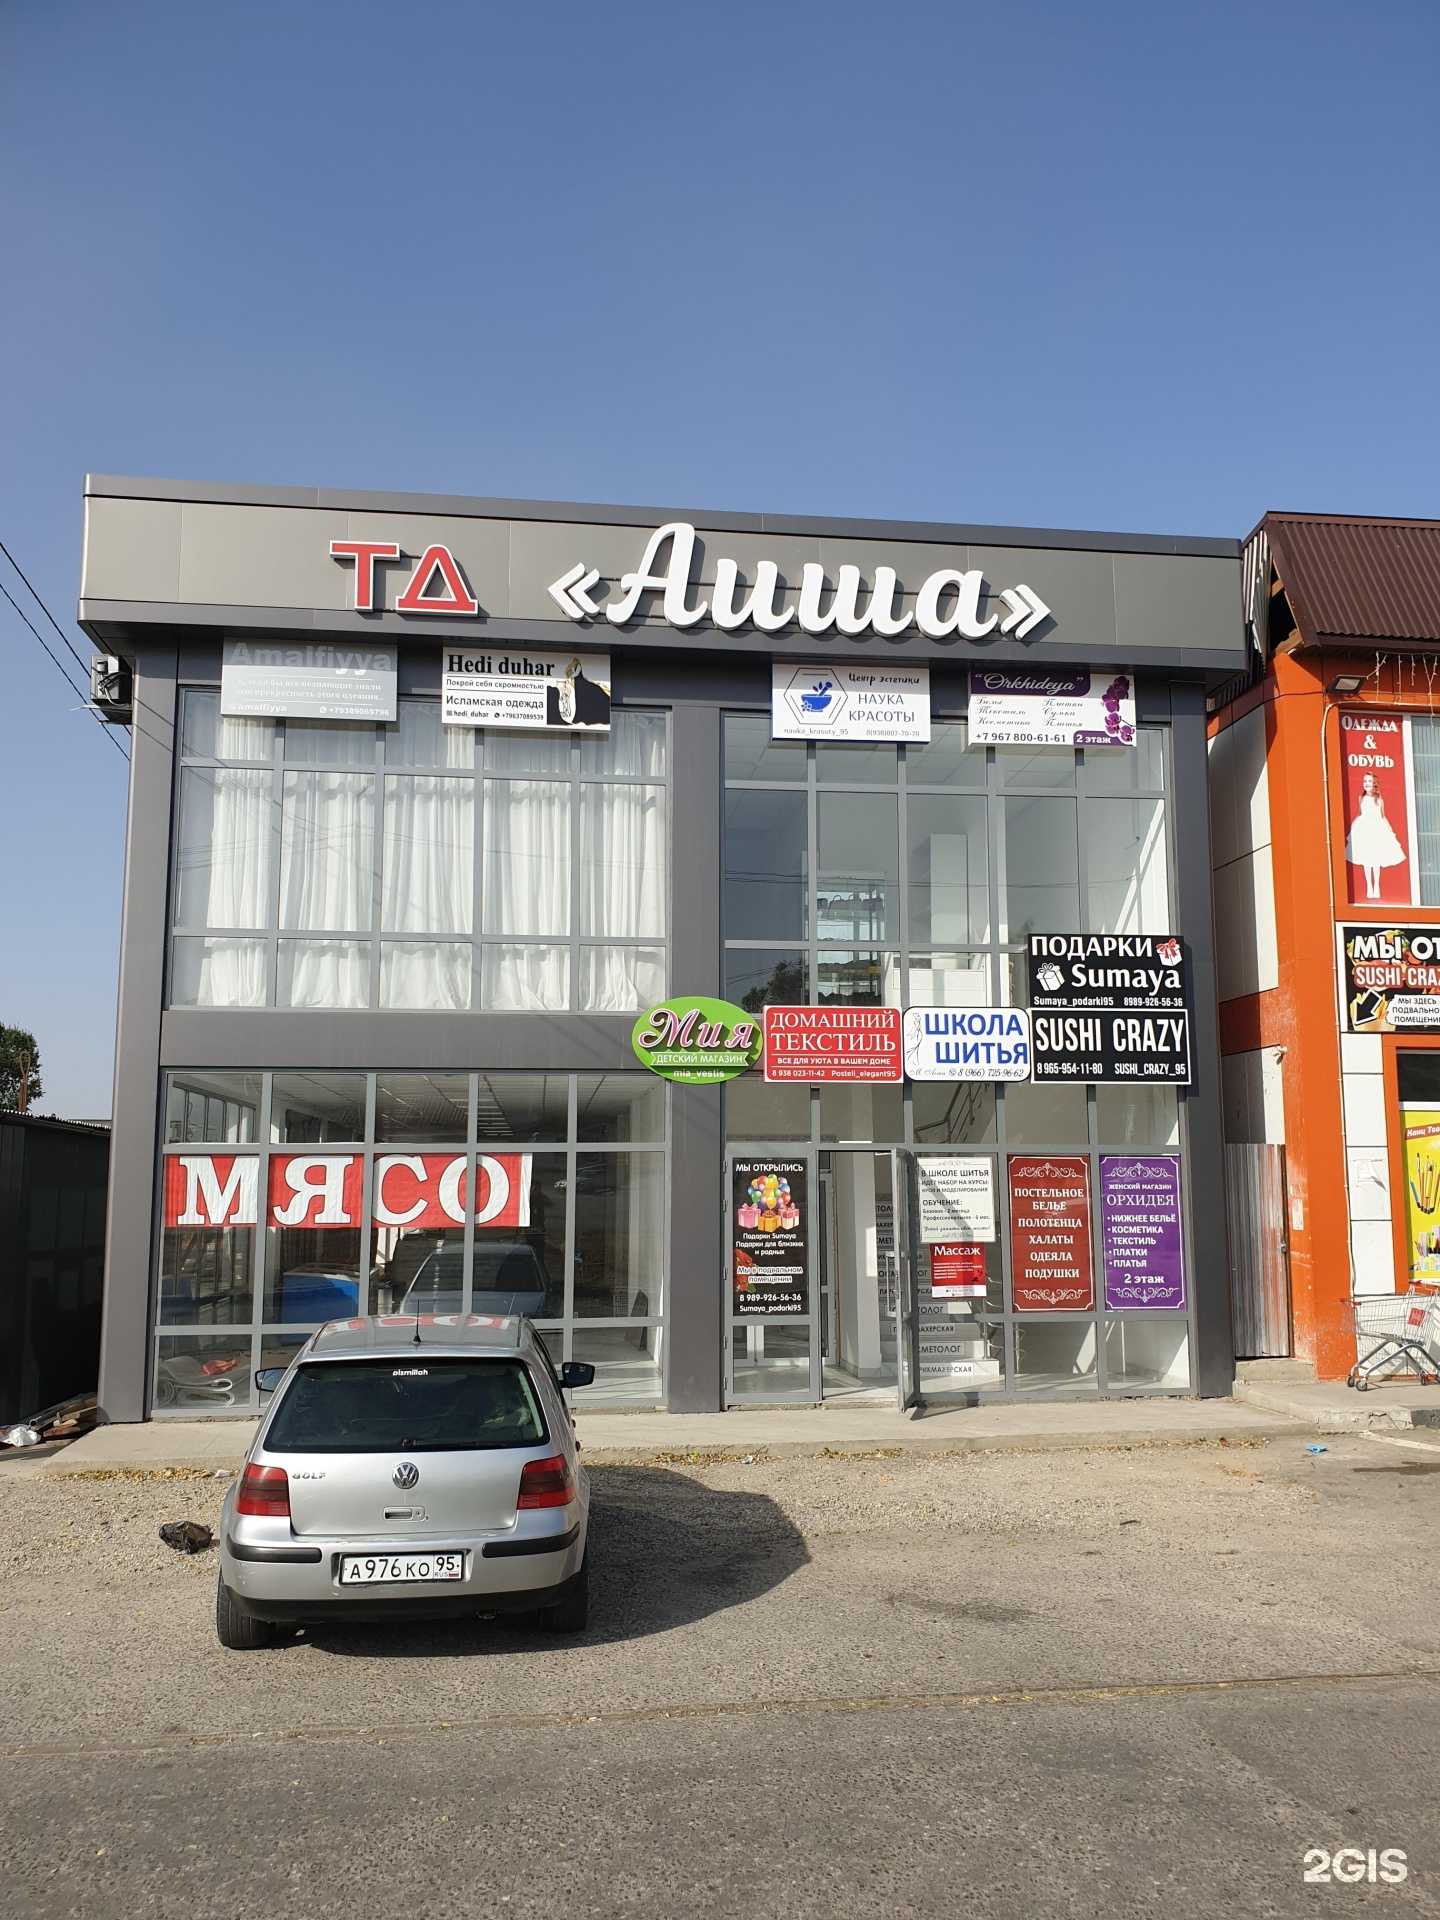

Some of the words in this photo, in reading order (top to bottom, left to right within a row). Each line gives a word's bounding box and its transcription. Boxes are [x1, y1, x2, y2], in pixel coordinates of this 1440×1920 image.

[329, 539, 478, 615] ТД
[230, 642, 392, 675] Amalfiyya
[448, 654, 492, 673] Hedi
[498, 657, 555, 676] duhar
[446, 679, 474, 687] Покрой
[849, 672, 875, 686] Центр
[880, 677, 919, 685] эстетики
[446, 695, 503, 707] Исламская
[506, 698, 543, 709] одежда
[858, 694, 904, 704] НАУКА
[849, 710, 915, 722] КРАСОТЫ
[992, 733, 1011, 741] 967
[1013, 734, 1066, 742] 800-61-61
[1364, 735, 1376, 749] &
[1348, 754, 1394, 768] ОБУВЬ
[1032, 936, 1152, 961] ПОДАРКИ
[1354, 935, 1402, 960] МЫ
[1071, 964, 1181, 996] Sumaya
[1356, 967, 1401, 985] SUSHI
[1408, 967, 1440, 985] CRA
[1034, 996, 1114, 1007] Sumaya_podarki95
[1124, 998, 1183, 1006] 8989-926-56-36
[771, 1010, 895, 1030] ДОМАШНИЙ
[925, 1014, 1023, 1036] ШКОЛА
[638, 1008, 753, 1048] Мия
[1036, 1018, 1101, 1051] SUSHI
[1113, 1019, 1183, 1052] CRAZY
[771, 1033, 896, 1051] ТЕКСТИЛЬ
[656, 1055, 698, 1063] ДЕТСКИЙ
[700, 1055, 742, 1063] МАГАЗИН
[936, 1042, 1028, 1064] ШИТЬЯ
[1037, 1063, 1043, 1073] 8
[1044, 1063, 1102, 1074] 965-954-11-80
[1115, 1064, 1186, 1076] SUSHI_CRAZY_95
[753, 1164, 803, 1172] ОТКРЫЛИСЬ
[177, 1154, 509, 1225] МЯСО
[1015, 1188, 1084, 1198] ПОСТЕЛЬНОЕ
[1107, 1194, 1175, 1208] ОРХИДЕЯ
[1018, 1218, 1082, 1229] ПОЛОТЕНЦА
[1150, 1214, 1177, 1222] БЕЛЬЁ
[1112, 1226, 1163, 1234] КОСМЕТИКА
[1029, 1235, 1073, 1244] ХАЛАТЫ
[1112, 1237, 1156, 1245] ТЕКСТИЛЬ
[934, 1245, 981, 1256] Массаж
[1113, 1248, 1147, 1256] ПЛАТКИ
[1030, 1252, 1072, 1262] ОДЕЯЛА
[1114, 1260, 1147, 1268] ПЛАТЬЯ
[1025, 1268, 1079, 1279] ПОДУШКИ
[1124, 1274, 1132, 1284] 2
[1134, 1276, 1164, 1284] этаж
[436, 1556, 455, 1571] 95
